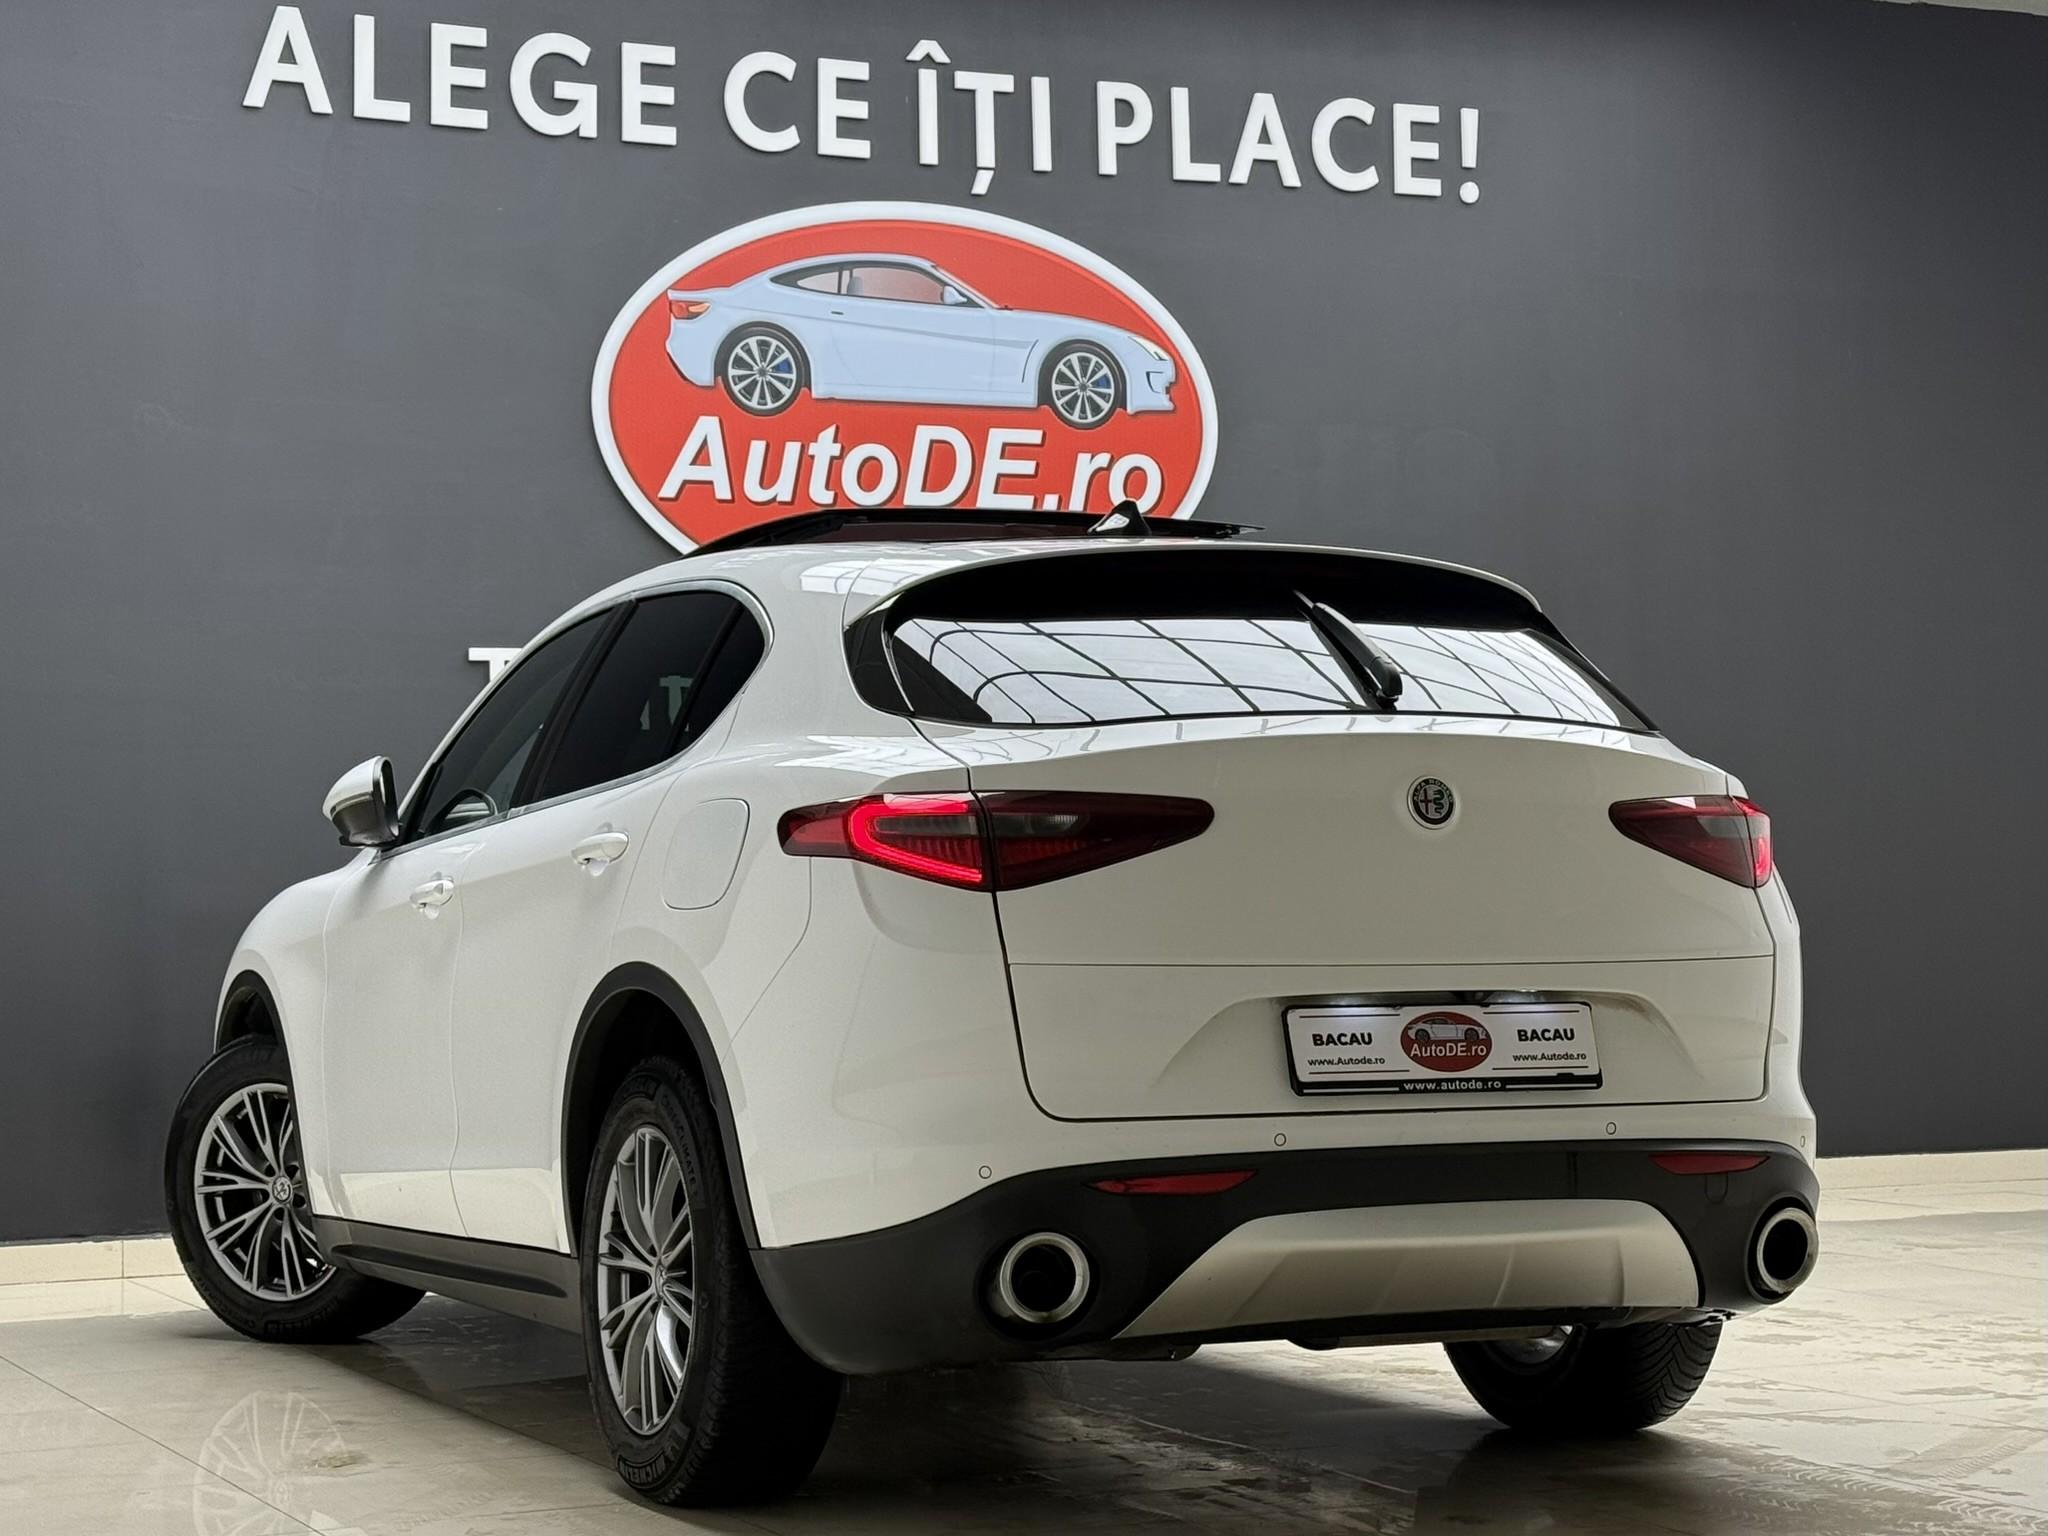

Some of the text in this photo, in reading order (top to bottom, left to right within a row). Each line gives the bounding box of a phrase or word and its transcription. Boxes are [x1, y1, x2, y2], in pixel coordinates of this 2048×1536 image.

[242, 5, 1480, 204] ALEGE CE ÎȚI PLACE!
[658, 415, 1163, 509] AutoDE.ro
[1312, 1032, 1373, 1046] BACAU
[1517, 1028, 1575, 1042] BACAU
[1410, 1042, 1487, 1057] AutoDE.ro
[1307, 1056, 1386, 1066] www.Autode.ro
[1512, 1052, 1587, 1062] www.Autode.ro
[1403, 1080, 1501, 1091] www.autode.ro
